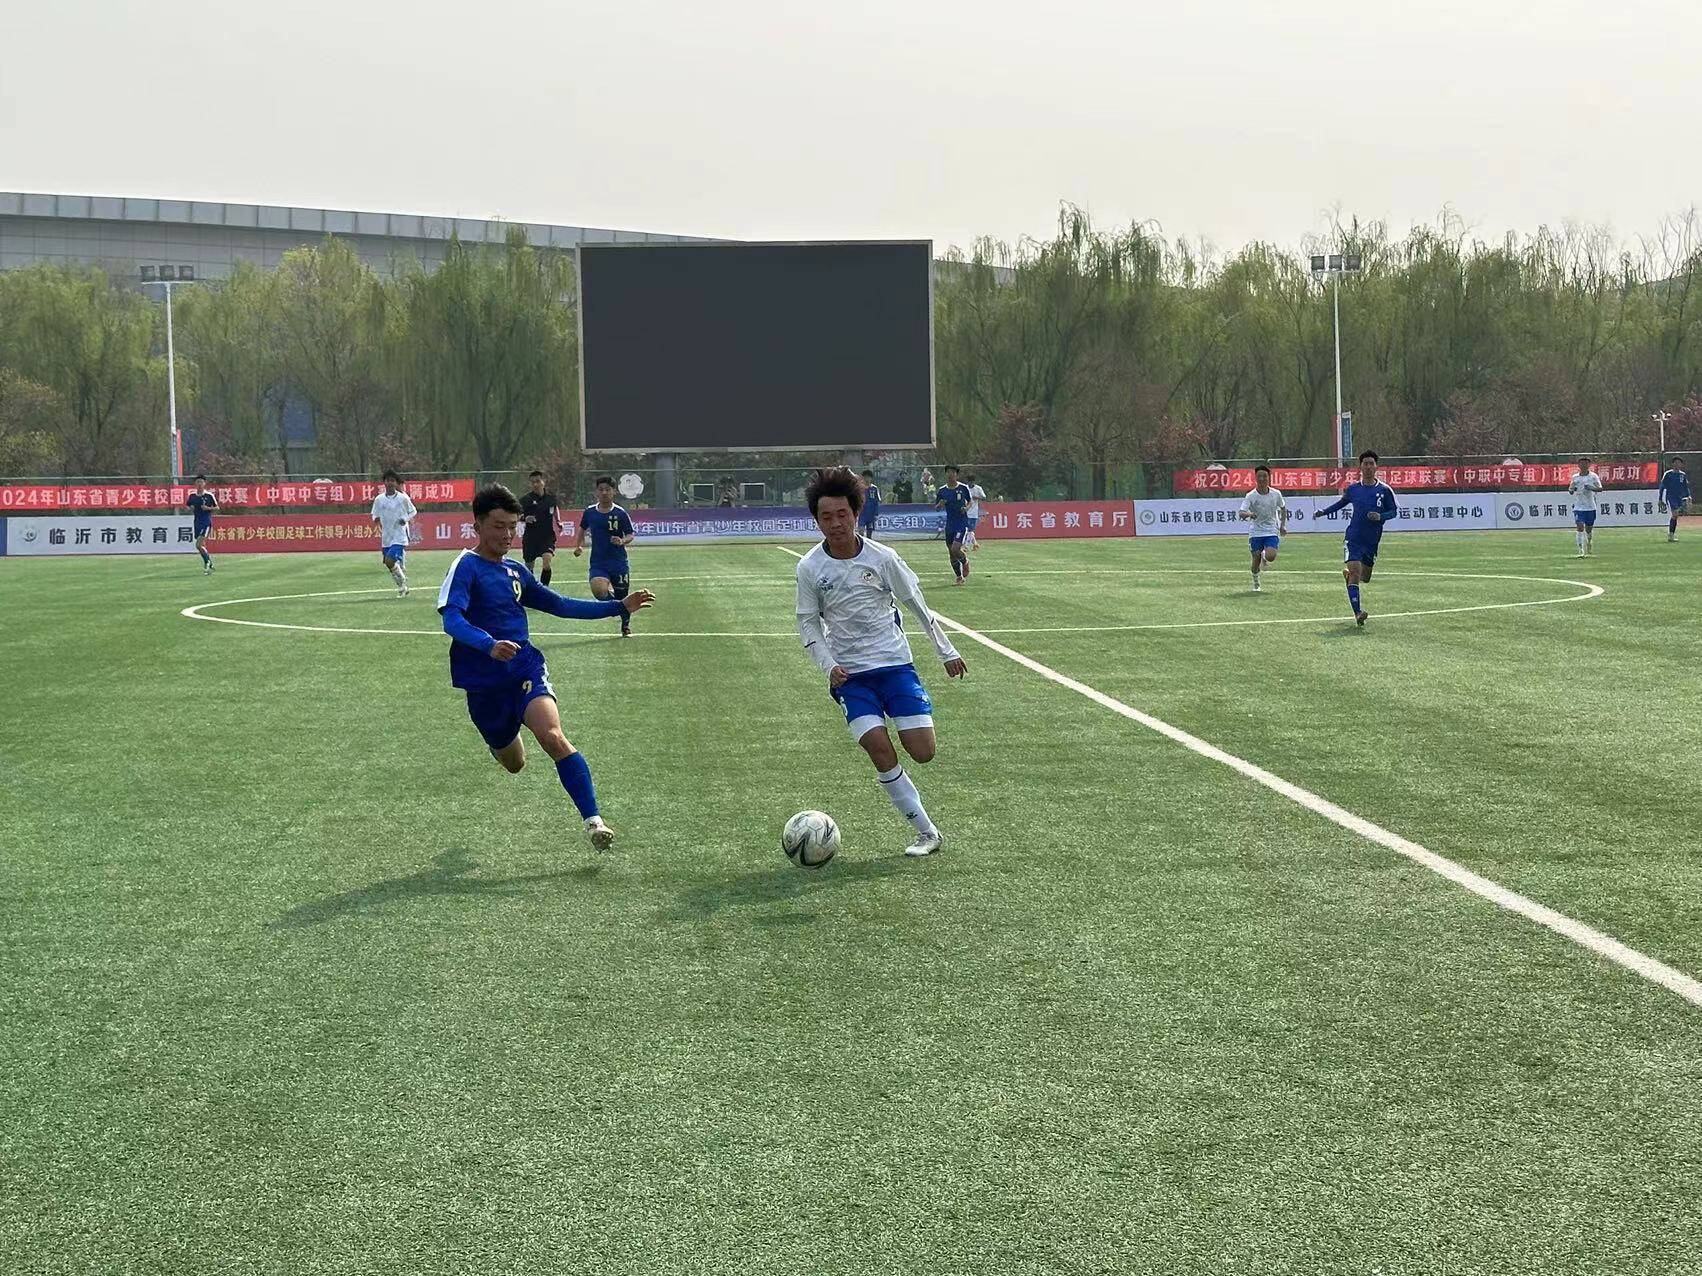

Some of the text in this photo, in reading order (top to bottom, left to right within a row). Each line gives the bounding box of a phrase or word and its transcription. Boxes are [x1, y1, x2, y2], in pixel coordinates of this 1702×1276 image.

[2, 482, 454, 506] 024年山东省青少年校园联赛（中职中专组）比满成功
[1327, 505, 1484, 521] 山东运动管理中心
[1529, 501, 1668, 517] 临沂研践教育营地
[607, 520, 619, 531] 14
[993, 510, 1128, 529] 山东省教育厅
[49, 526, 194, 545] 临沂市教育局
[512, 579, 522, 603] 9
